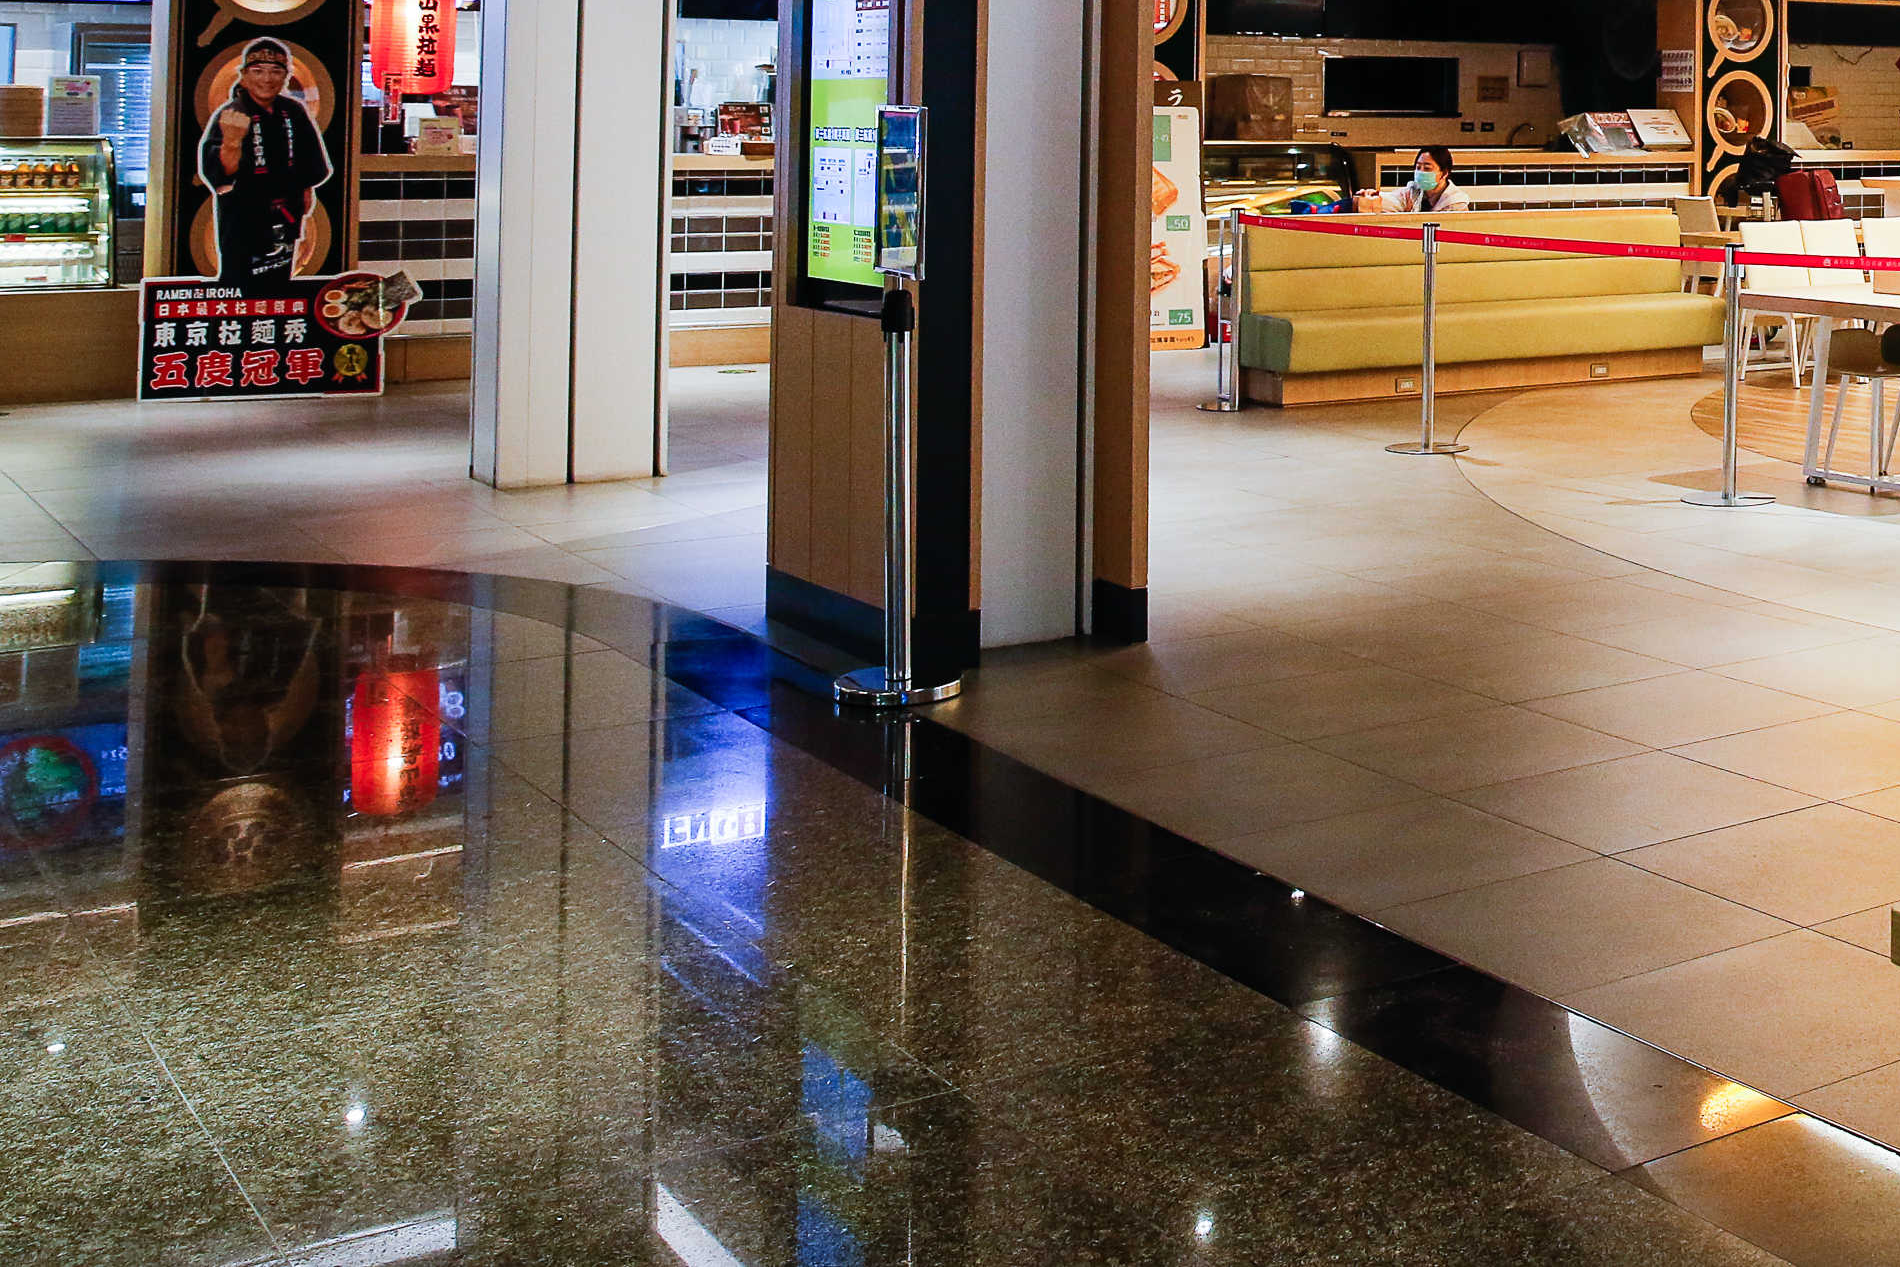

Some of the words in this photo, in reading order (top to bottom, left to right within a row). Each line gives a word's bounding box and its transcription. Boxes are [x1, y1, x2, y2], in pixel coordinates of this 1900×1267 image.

[156, 289, 192, 301] RAMEN
[206, 287, 243, 299] IROHA
[153, 318, 307, 347] 東京拉麵秀
[150, 347, 326, 391] 五度冠軍
